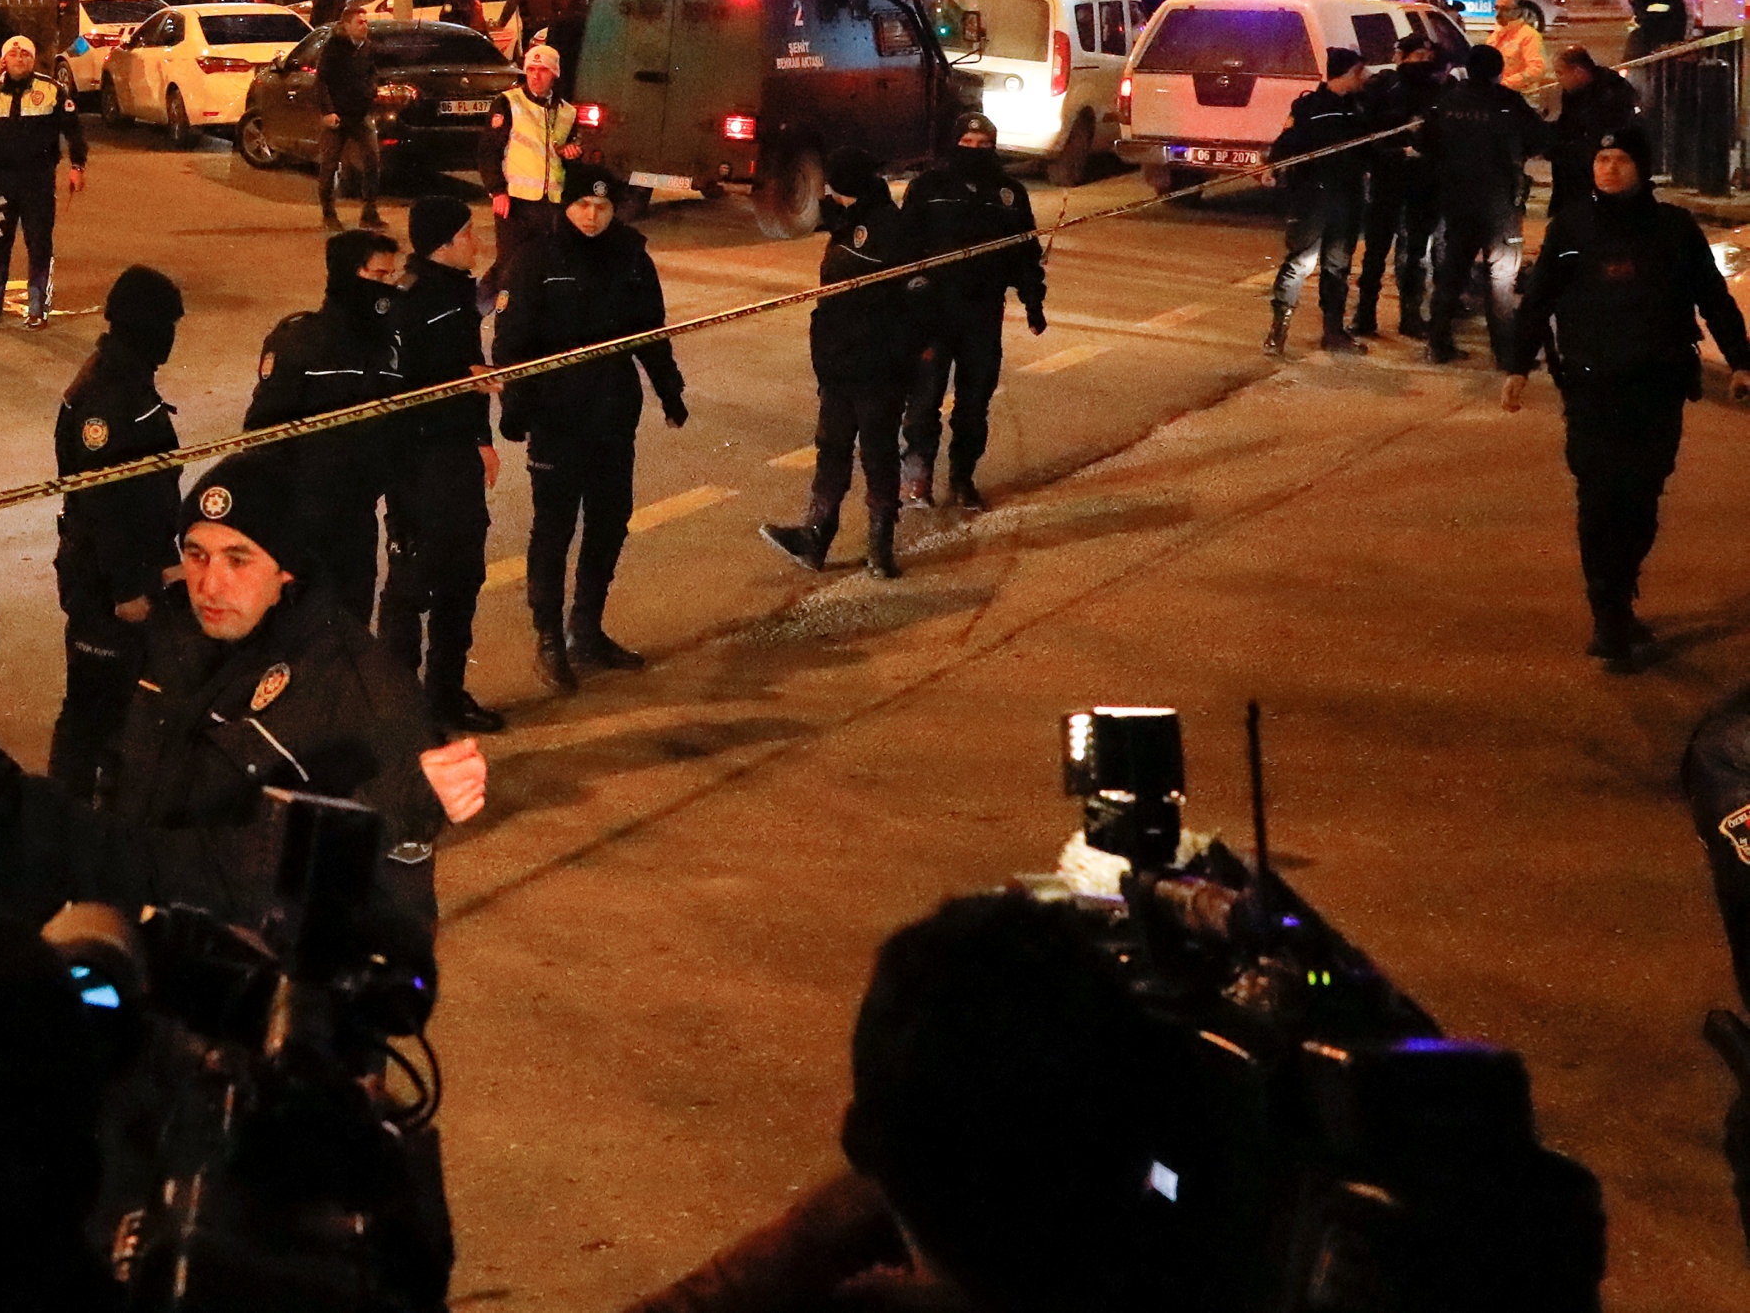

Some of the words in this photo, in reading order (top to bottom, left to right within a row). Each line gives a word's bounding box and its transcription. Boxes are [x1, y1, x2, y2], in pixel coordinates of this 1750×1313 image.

[793, 0, 804, 26] 2
[1198, 150, 1209, 160] 06
[1216, 151, 1228, 161] BP
[1232, 152, 1257, 163] 2078
